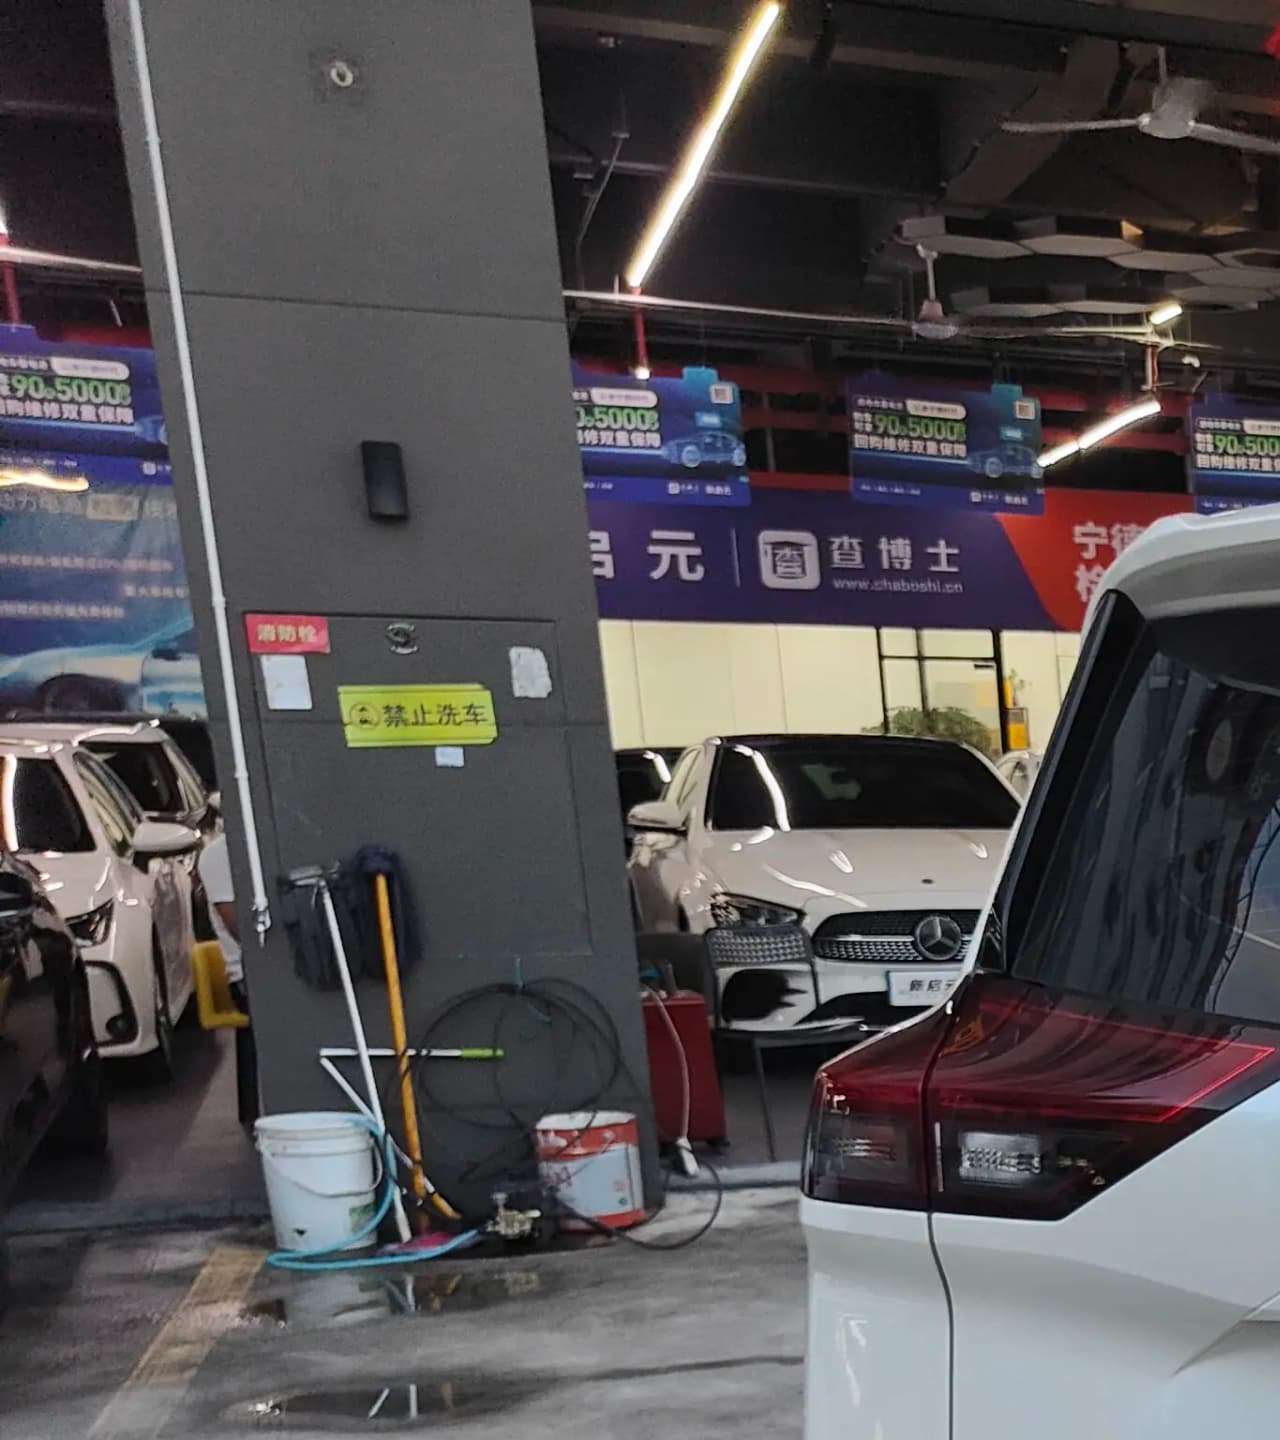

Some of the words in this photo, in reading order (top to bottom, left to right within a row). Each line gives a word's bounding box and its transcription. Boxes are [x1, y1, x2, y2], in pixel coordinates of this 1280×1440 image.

[829, 535, 961, 573] 查博士
[832, 577, 964, 594] www.chaboshi.cn
[256, 623, 317, 643] 消防栓
[383, 703, 489, 728] 禁止洗车
